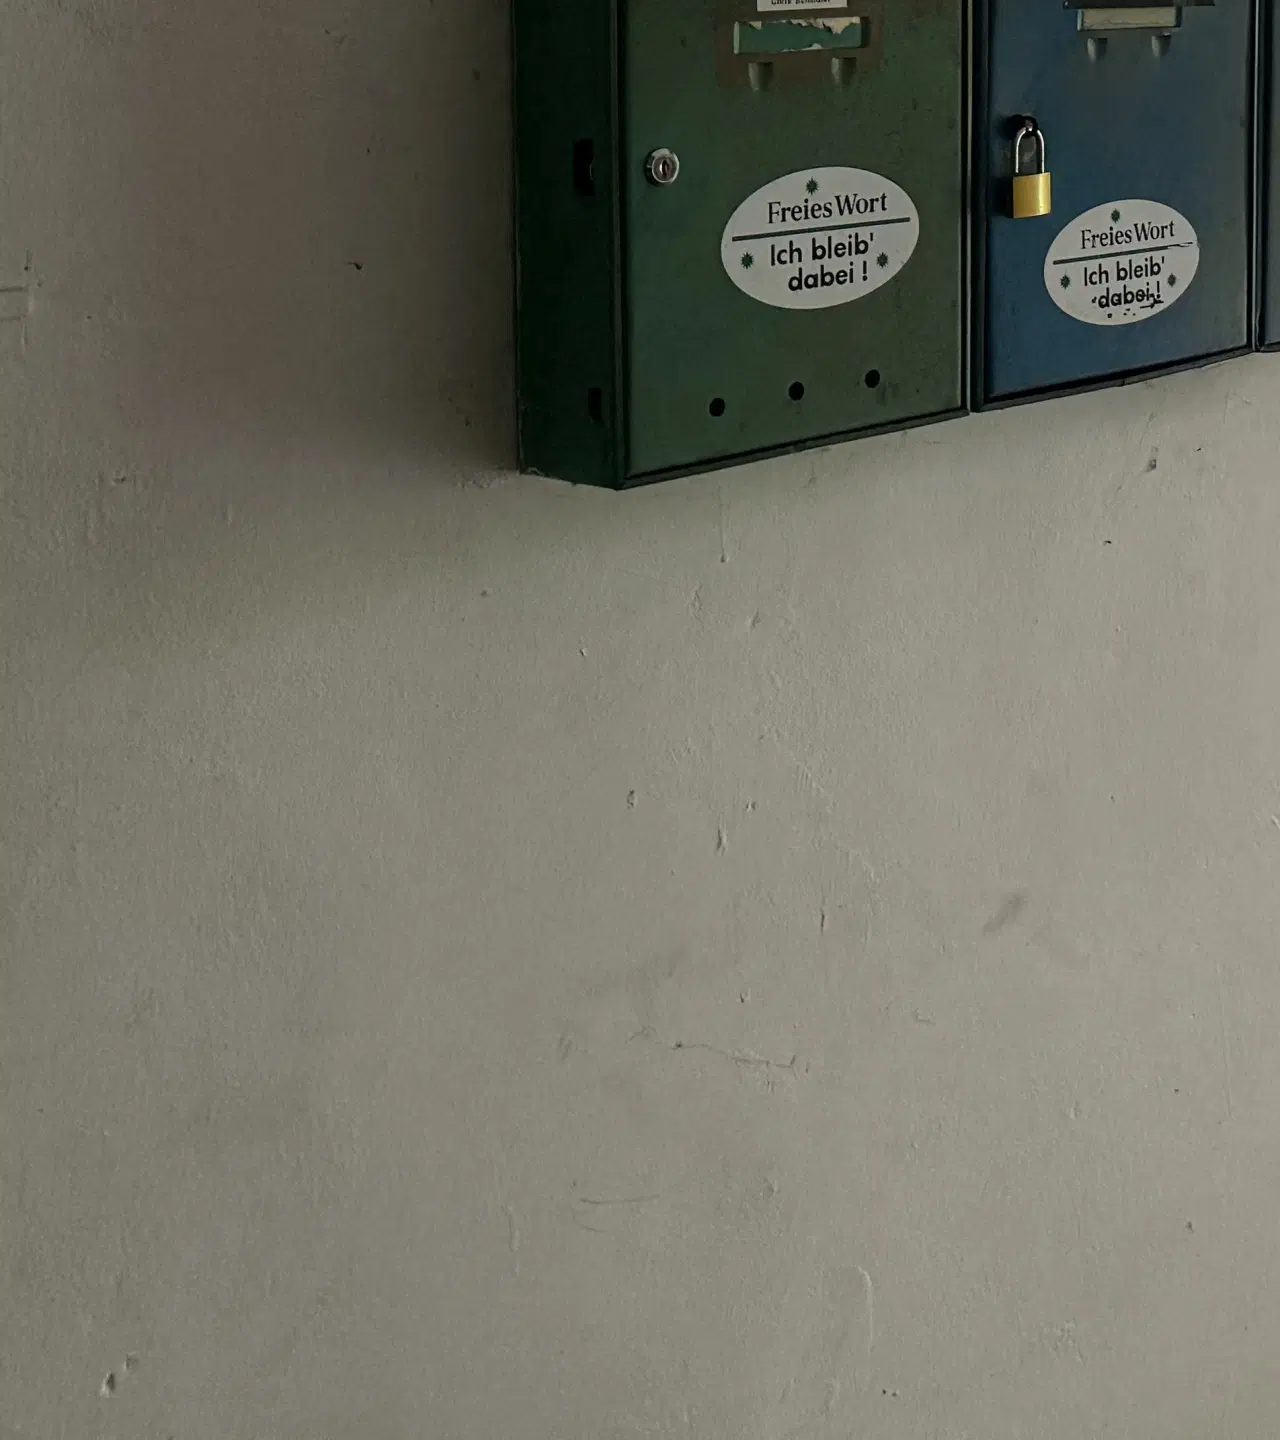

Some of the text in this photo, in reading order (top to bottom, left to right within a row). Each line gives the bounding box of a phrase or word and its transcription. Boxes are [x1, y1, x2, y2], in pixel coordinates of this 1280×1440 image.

[768, 192, 888, 224] Freies Wort
[771, 232, 873, 266] Ich bleib'
[1081, 221, 1175, 249] Freies Wort
[1084, 256, 1165, 286] Ich bleib'
